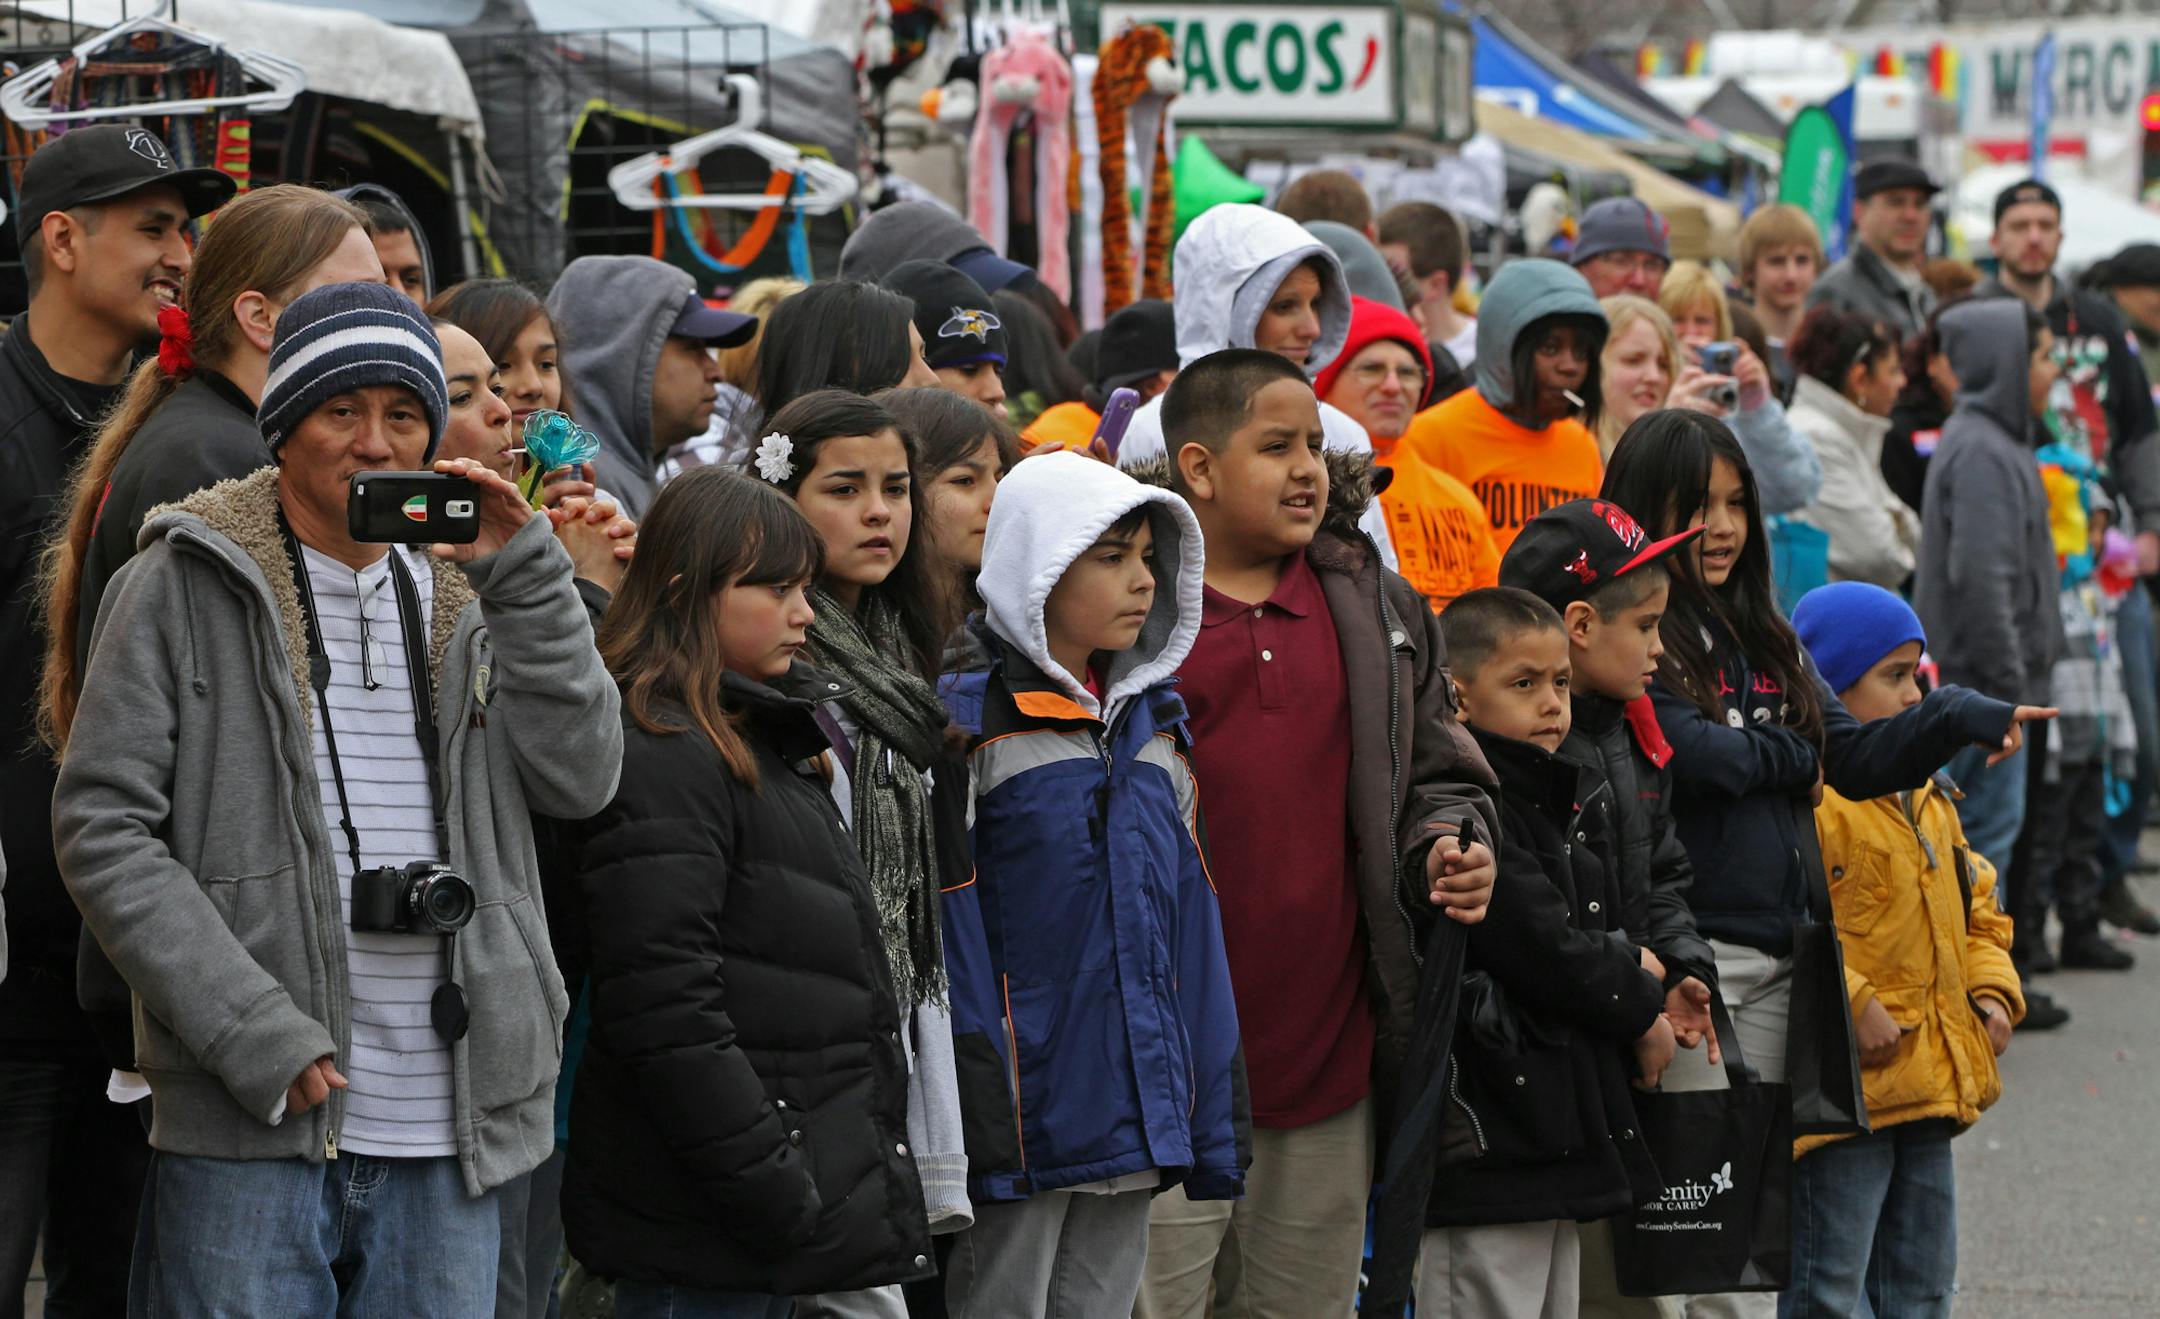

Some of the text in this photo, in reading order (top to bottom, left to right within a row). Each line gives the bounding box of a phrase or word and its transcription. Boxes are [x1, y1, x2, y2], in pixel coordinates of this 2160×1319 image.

[1140, 19, 1344, 94] ACOS
[1660, 1178, 1715, 1208] enity
[1666, 1200, 1699, 1211] CARE
